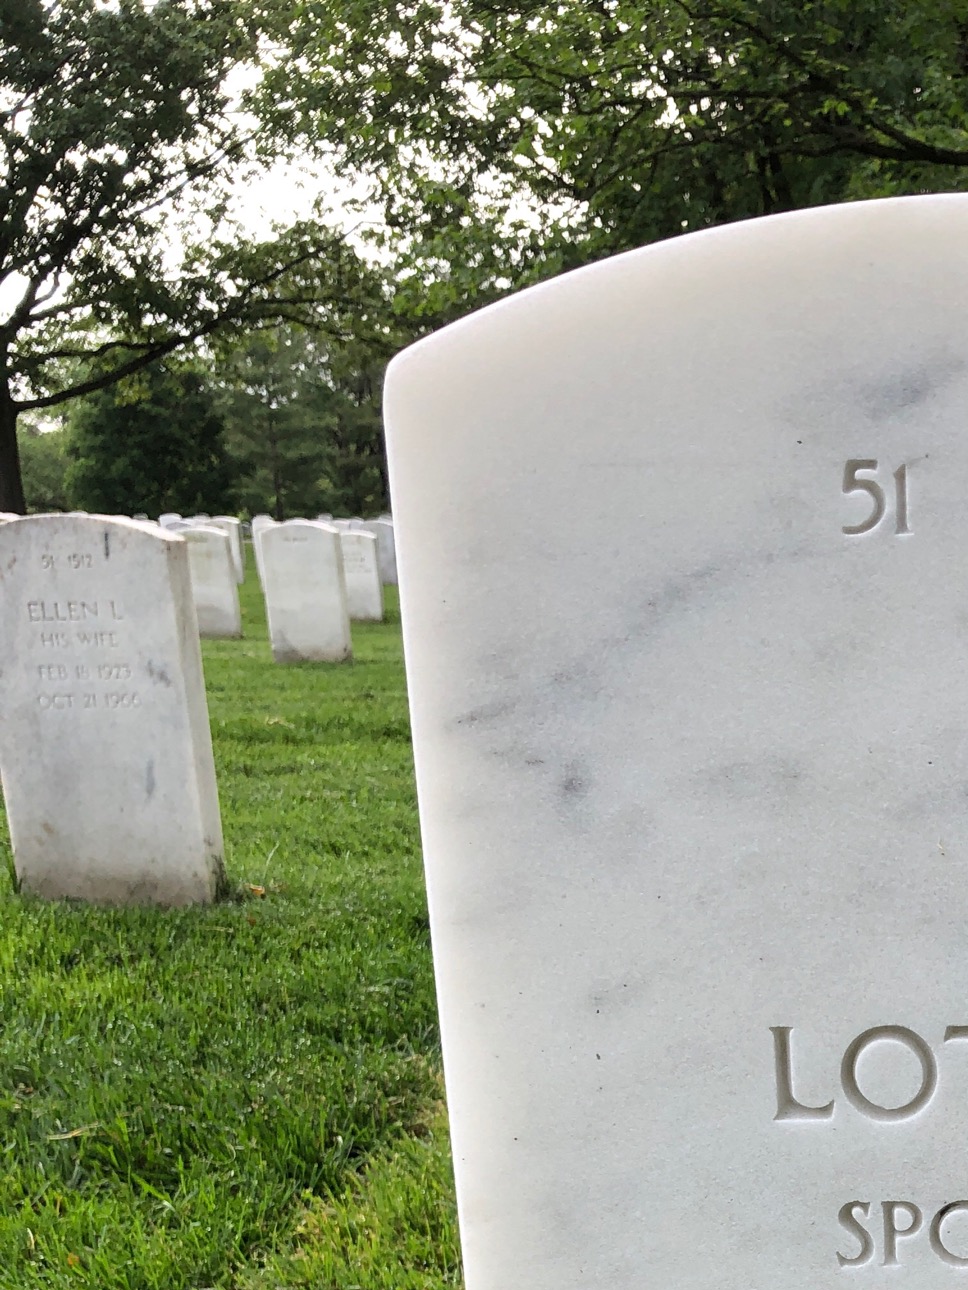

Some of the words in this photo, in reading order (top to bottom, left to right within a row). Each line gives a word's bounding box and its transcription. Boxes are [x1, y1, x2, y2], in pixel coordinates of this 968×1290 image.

[841, 458, 914, 535] 51
[27, 600, 98, 621] ELLEN
[110, 600, 123, 620] L
[40, 632, 68, 648] HIS
[76, 631, 120, 648] WIFE
[39, 664, 68, 680] FEB
[37, 692, 74, 710] OCT
